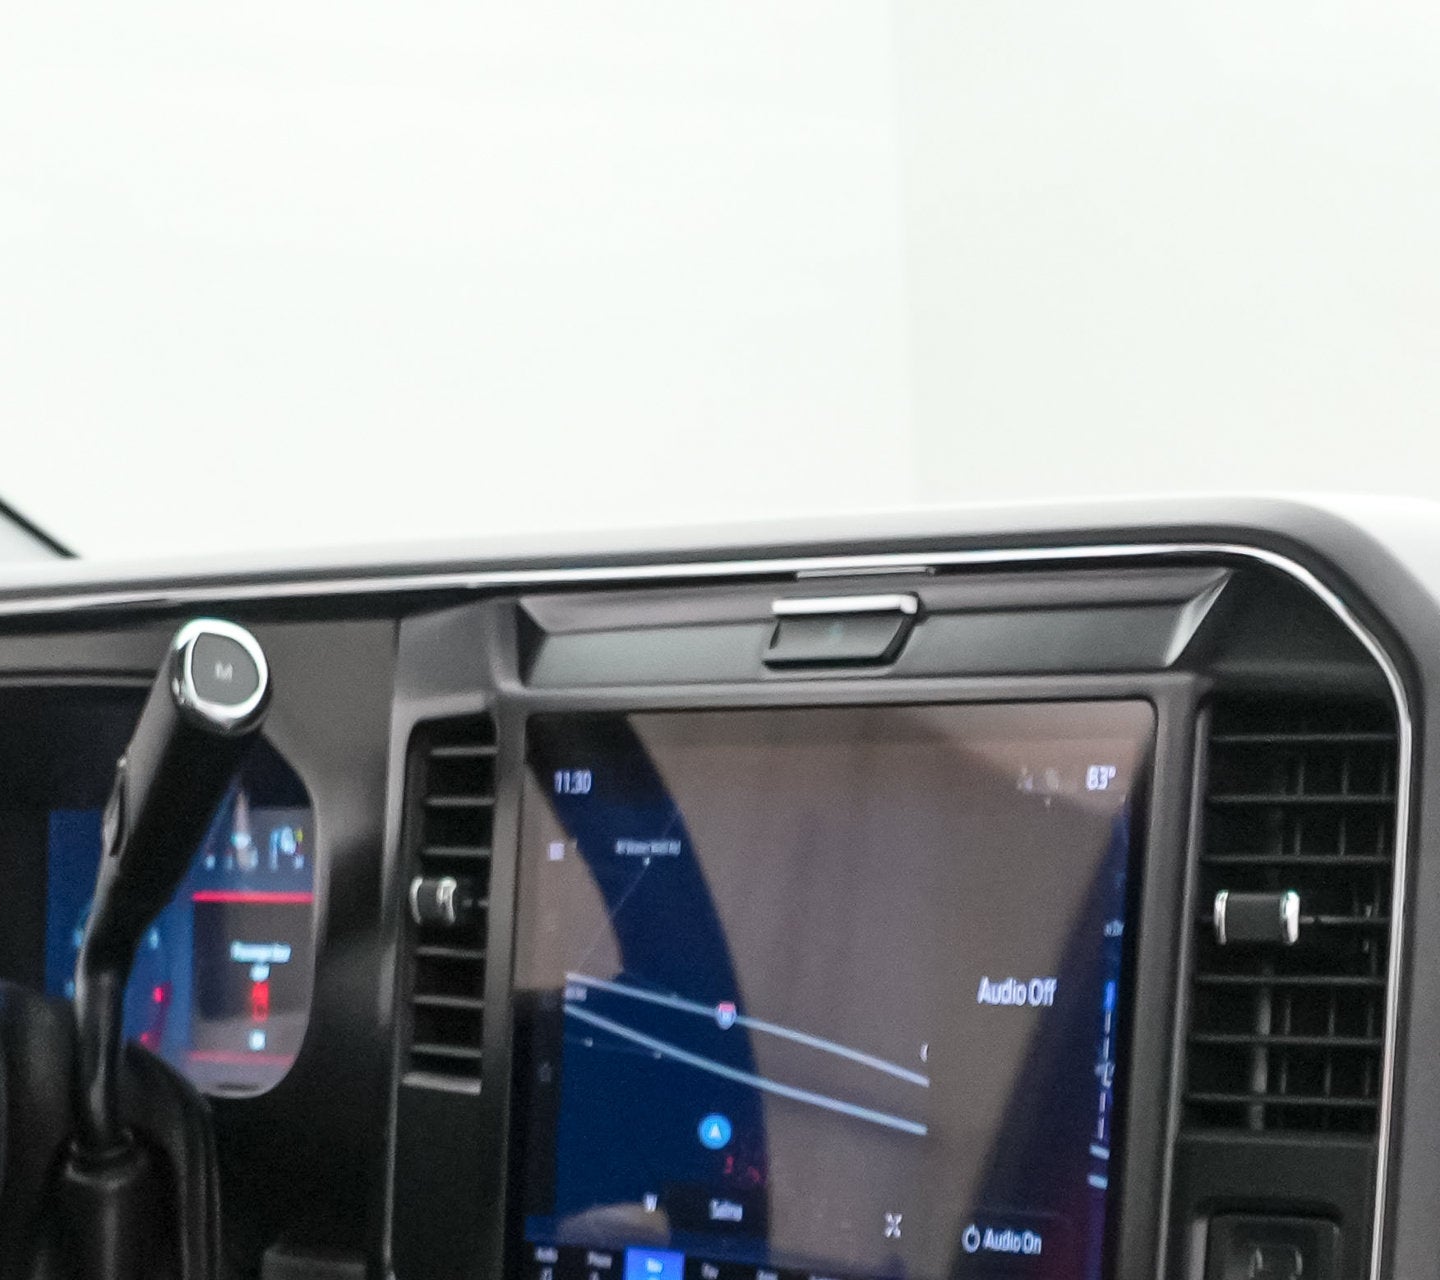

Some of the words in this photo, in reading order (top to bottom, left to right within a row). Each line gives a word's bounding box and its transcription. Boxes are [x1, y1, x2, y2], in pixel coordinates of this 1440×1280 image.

[977, 976, 1027, 1006] Audio
[1028, 977, 1058, 1006] Off
[983, 1228, 1021, 1250] Audio
[1022, 1230, 1042, 1254] On
